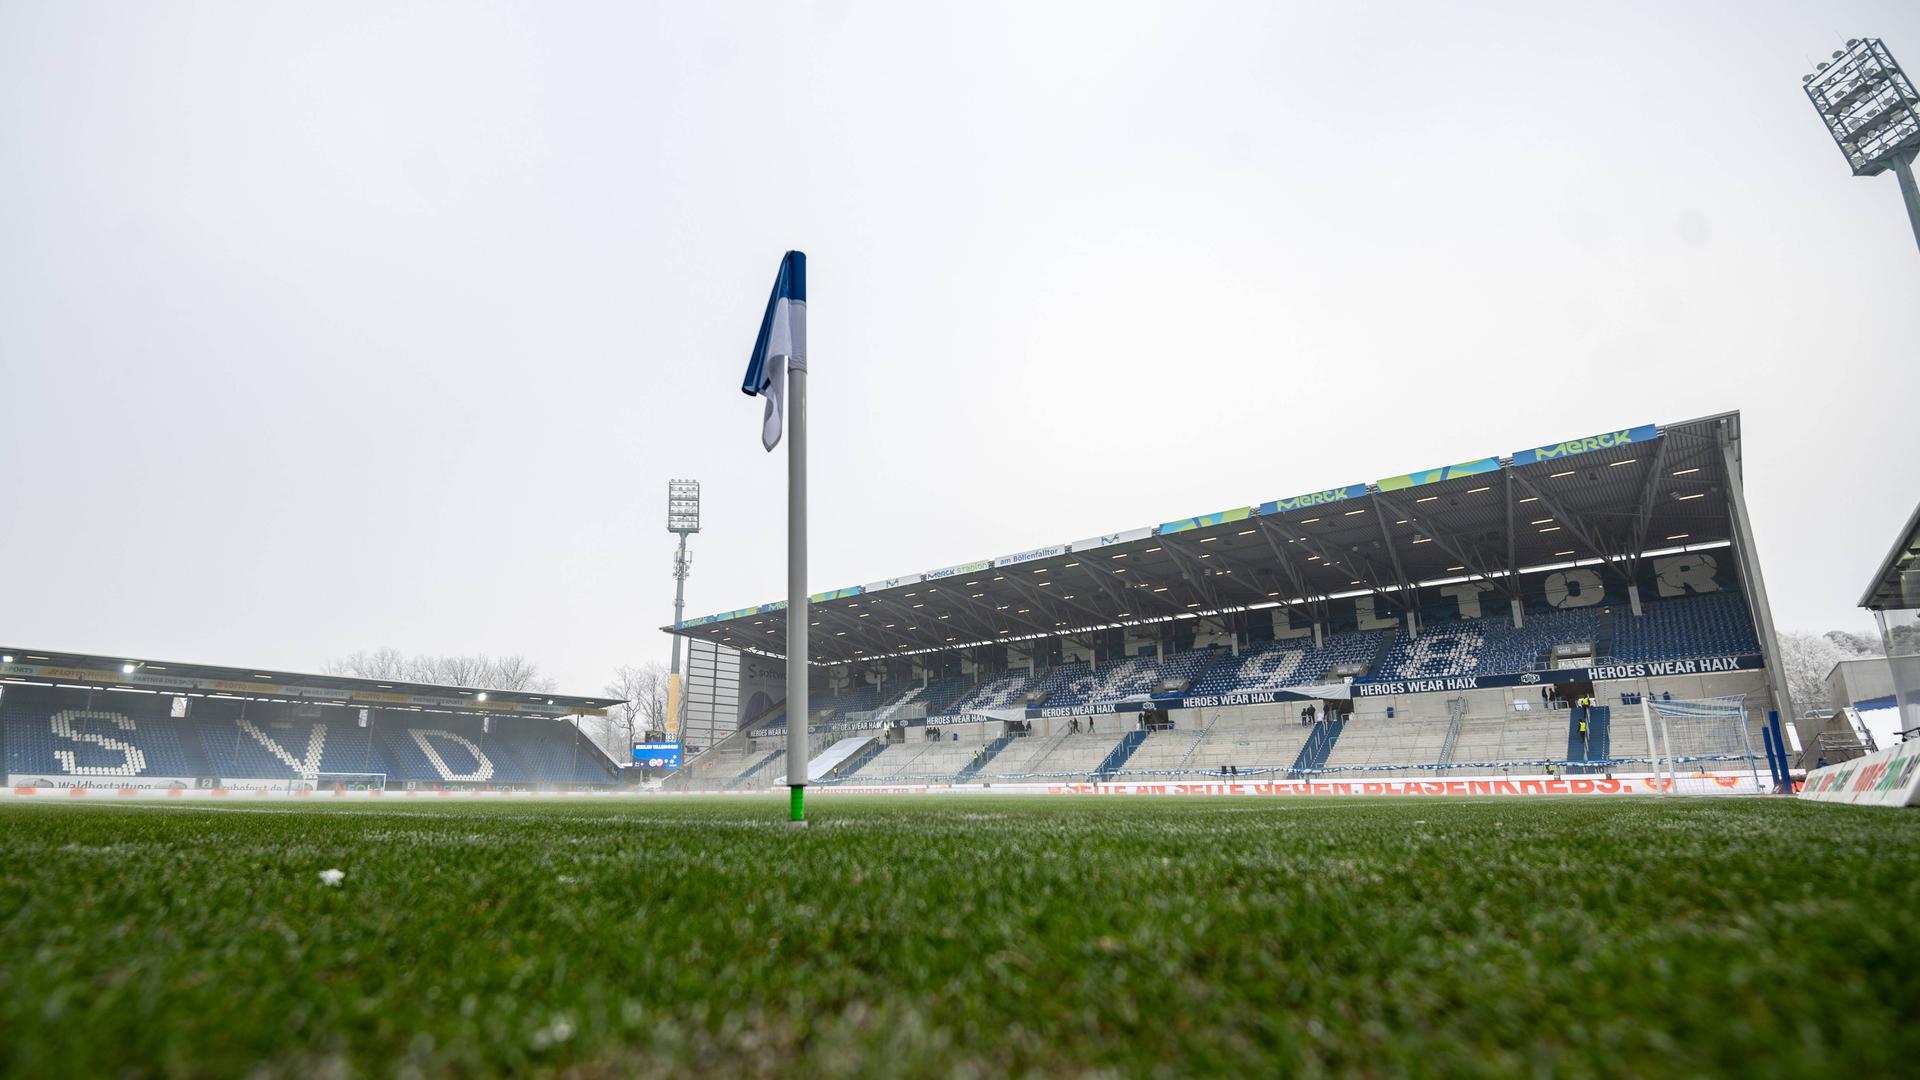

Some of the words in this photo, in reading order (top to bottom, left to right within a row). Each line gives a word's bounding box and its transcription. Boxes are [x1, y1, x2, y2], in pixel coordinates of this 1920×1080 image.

[1000, 558, 1011, 566] am
[1013, 548, 1058, 563] Böllenfalltor
[1588, 664, 1646, 680] HEROES
[1649, 660, 1696, 676] WEAR
[1700, 657, 1740, 672] HAIX
[1360, 683, 1405, 696] HEROES
[1407, 680, 1445, 693] WEAR
[1447, 677, 1478, 690] HAIX
[1183, 696, 1219, 708] HEROES
[1221, 694, 1249, 706] WEAR
[1251, 692, 1275, 703] HAIX
[926, 715, 950, 725] HEROES
[951, 714, 971, 724] WEAR
[1042, 707, 1070, 718] HEROES
[1072, 705, 1095, 716] WEAR
[1097, 704, 1116, 714] HAIX
[50, 710, 146, 776] S
[236, 719, 328, 779] V
[408, 729, 495, 781] D
[1174, 784, 1245, 795] SEITE
[1254, 783, 1353, 795] GEGEN
